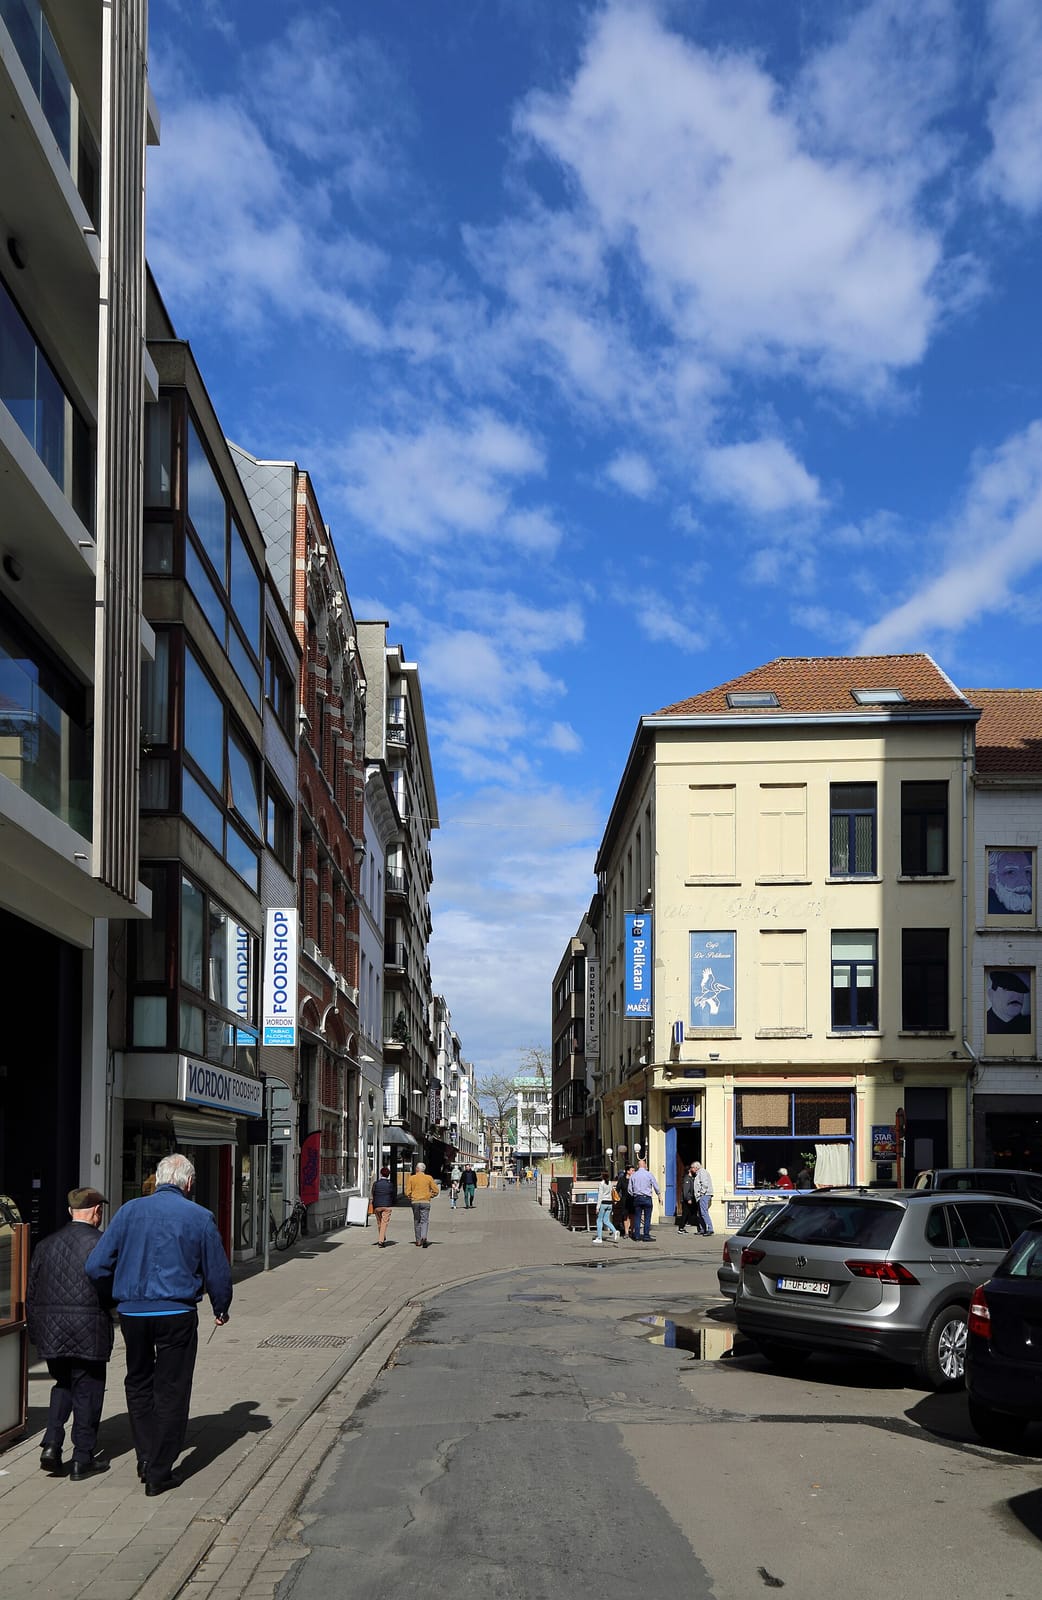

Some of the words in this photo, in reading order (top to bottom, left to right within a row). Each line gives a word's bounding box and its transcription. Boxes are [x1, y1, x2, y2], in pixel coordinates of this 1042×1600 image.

[633, 919, 645, 935] De
[273, 911, 288, 1014] FOODSHOP
[633, 940, 646, 991] Pelikaan
[627, 1004, 647, 1012] MAES
[232, 1079, 260, 1102] FOODSHOP
[671, 1105, 688, 1113] MAES
[873, 1133, 892, 1141] STAR
